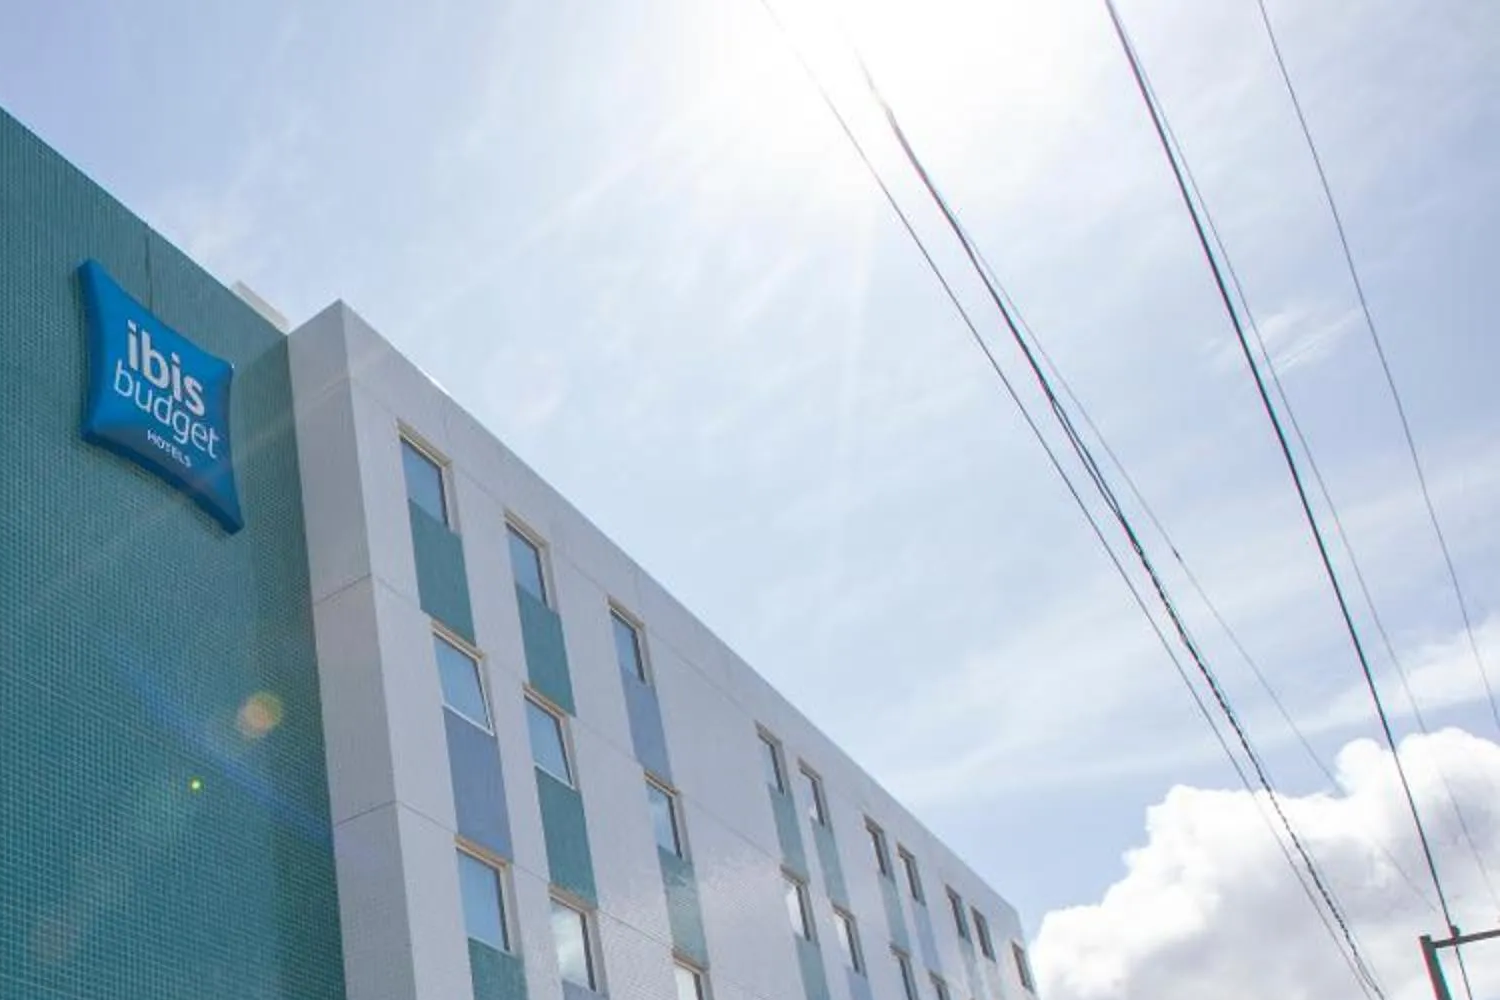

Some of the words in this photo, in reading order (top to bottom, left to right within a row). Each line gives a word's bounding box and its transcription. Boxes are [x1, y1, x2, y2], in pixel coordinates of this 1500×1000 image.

[113, 359, 220, 460] budget
[126, 319, 206, 418] ibis
[146, 428, 193, 468] HOTELS
